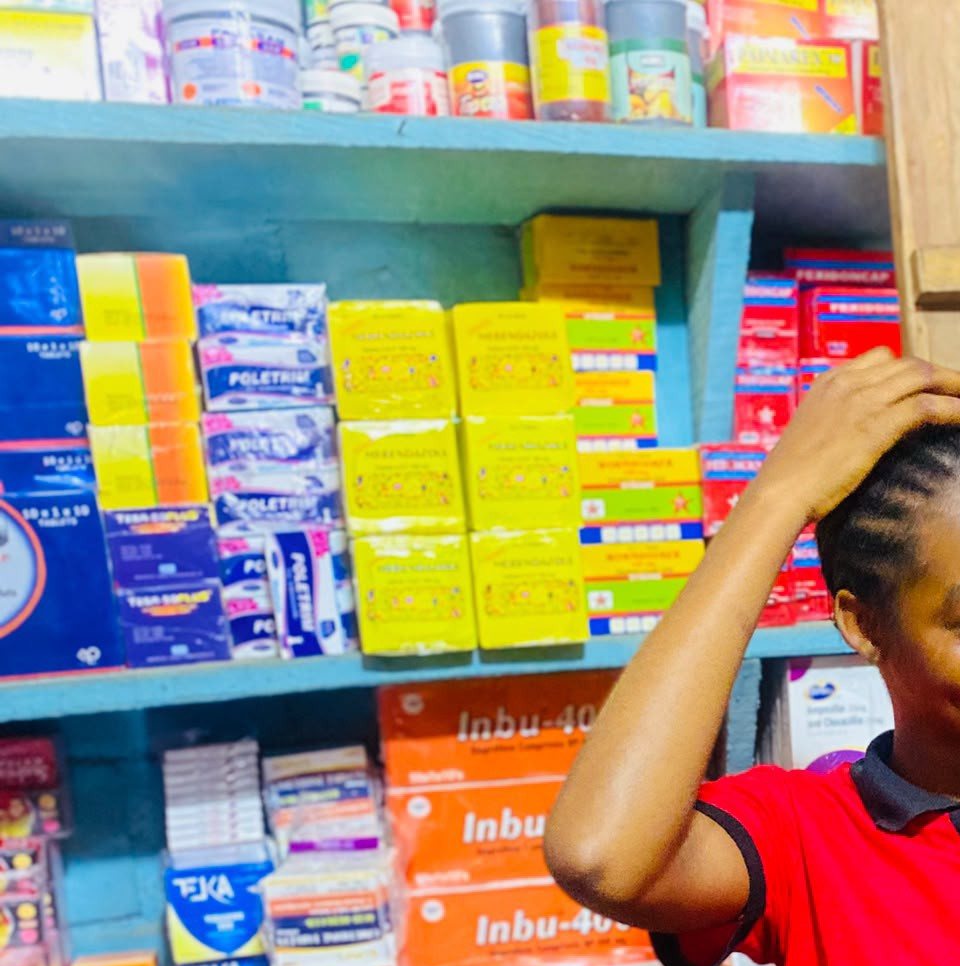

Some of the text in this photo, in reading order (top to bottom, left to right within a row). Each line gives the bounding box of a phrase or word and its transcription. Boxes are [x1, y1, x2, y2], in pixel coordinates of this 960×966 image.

[457, 705, 597, 742] Inbu-40
[463, 807, 547, 843] Inbu
[475, 906, 632, 946] Inbu-40
